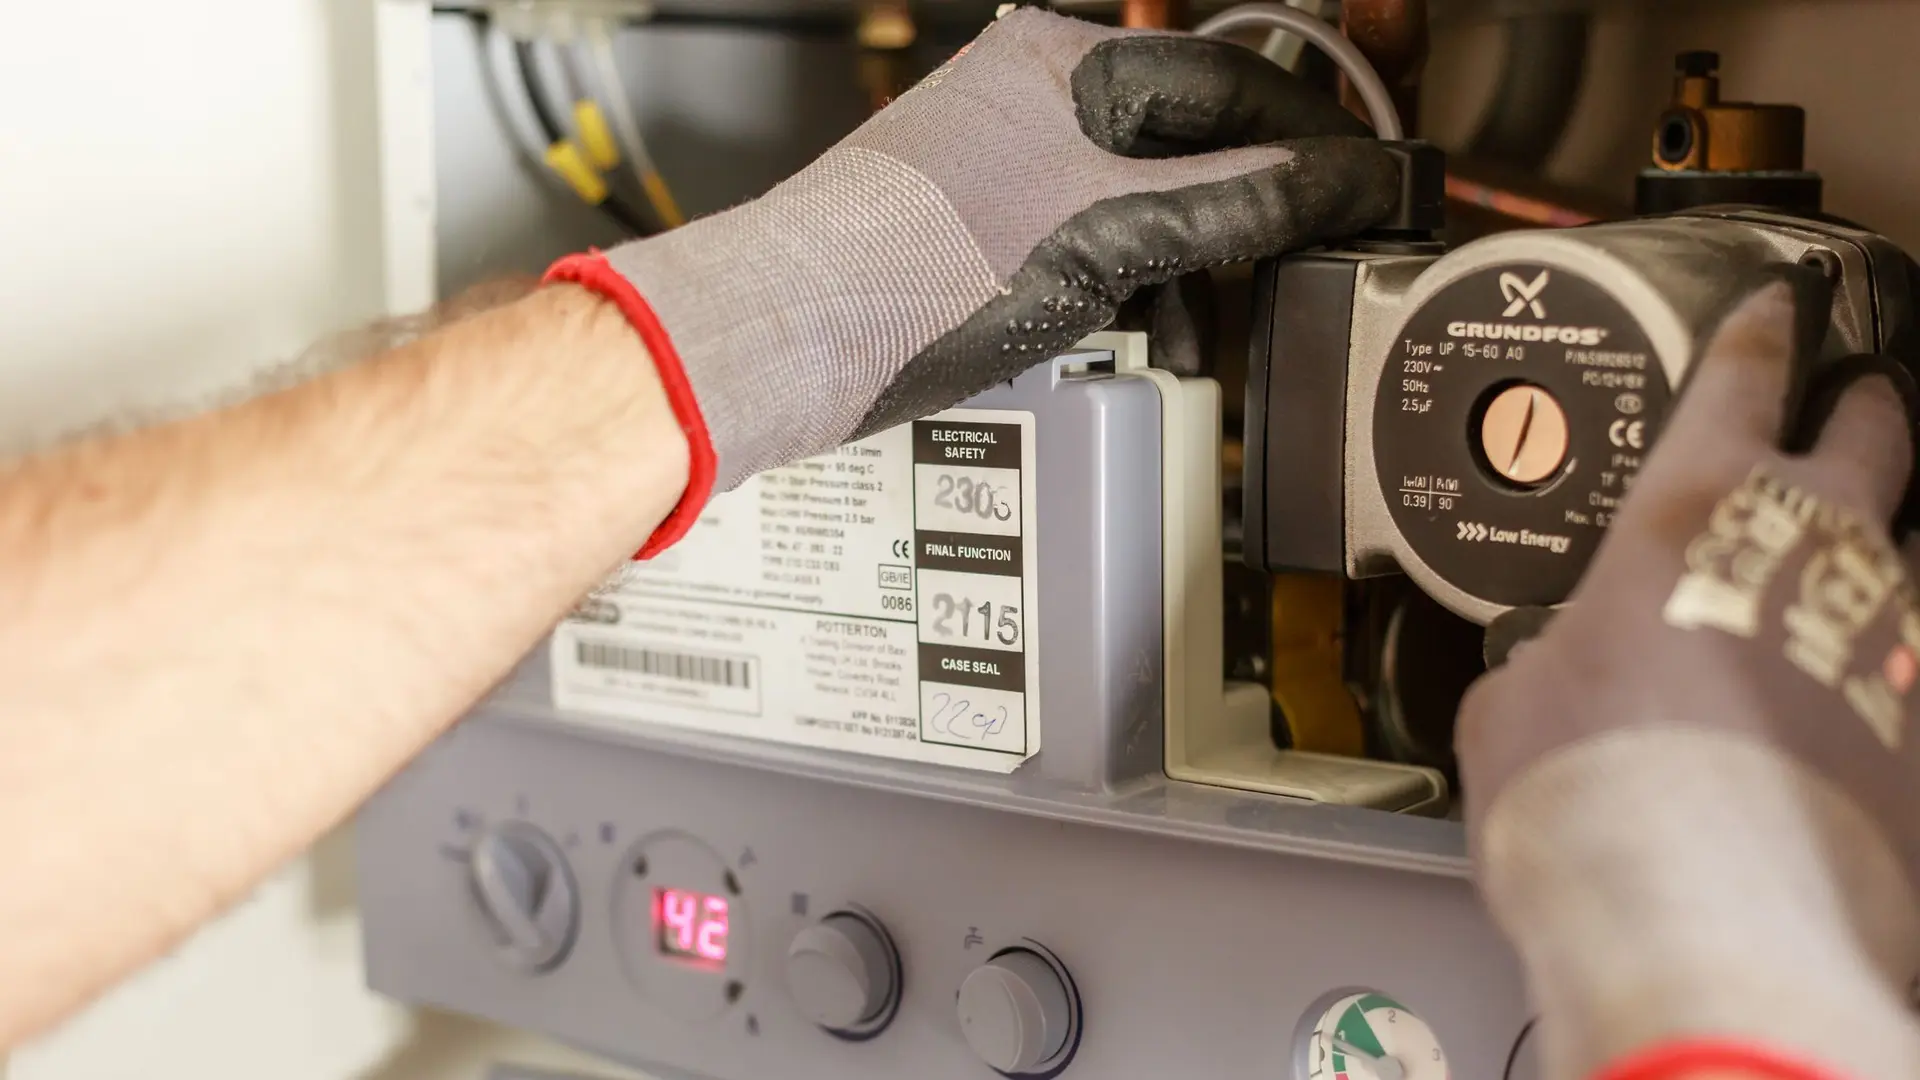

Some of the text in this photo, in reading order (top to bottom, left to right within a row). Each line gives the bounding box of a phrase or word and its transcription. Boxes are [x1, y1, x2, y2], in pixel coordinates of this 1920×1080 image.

[1447, 320, 1603, 346] GRUNDFOS
[1404, 339, 1432, 355] Type
[1439, 342, 1455, 356] UP
[1462, 344, 1498, 359] 15-60
[1402, 379, 1429, 393] 50Hz
[931, 429, 997, 444] ELECTRICAL
[944, 446, 986, 459] SAFETY
[848, 463, 866, 476] deg
[851, 480, 876, 491] class
[877, 481, 884, 492] 2
[852, 498, 868, 507] bar
[1402, 494, 1453, 510] 0.39 90
[860, 515, 876, 525] bar
[1490, 526, 1572, 553] Low Energy
[925, 543, 1012, 561] FINAL FUNCTION
[880, 571, 909, 584] GB/IE
[881, 595, 912, 611] 0086
[932, 592, 1019, 646] 2115
[816, 620, 888, 639] POTTERTON
[941, 657, 1001, 675] CASE SEAL
[662, 889, 728, 959] 42
[1388, 1009, 1397, 1024] 2
